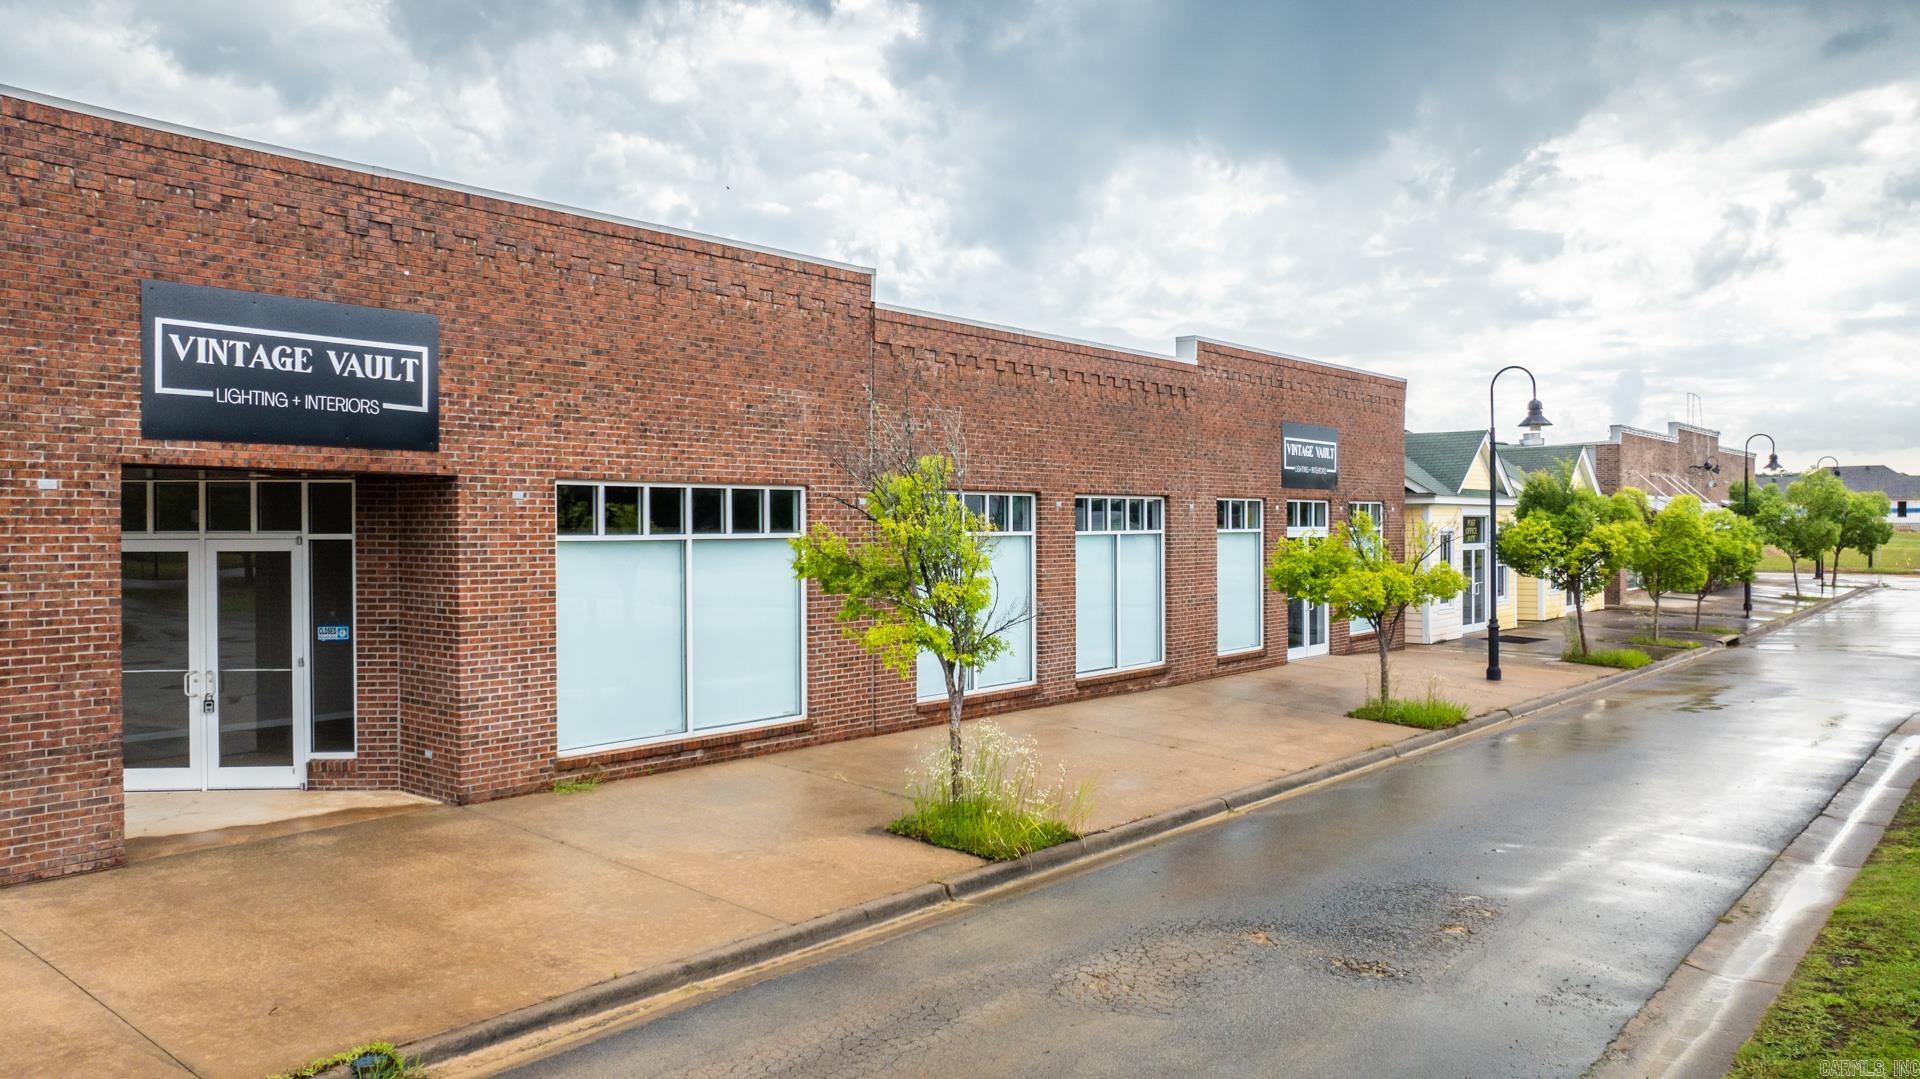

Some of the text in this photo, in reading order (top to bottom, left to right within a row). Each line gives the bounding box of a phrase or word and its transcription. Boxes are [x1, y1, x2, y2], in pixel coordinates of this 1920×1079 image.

[168, 333, 420, 382] VINTAGE VAULT
[216, 387, 380, 415] LIGHTING + INTERIORS
[1287, 443, 1335, 459] VINTAGE VAULT
[319, 627, 336, 635] CLOSED
